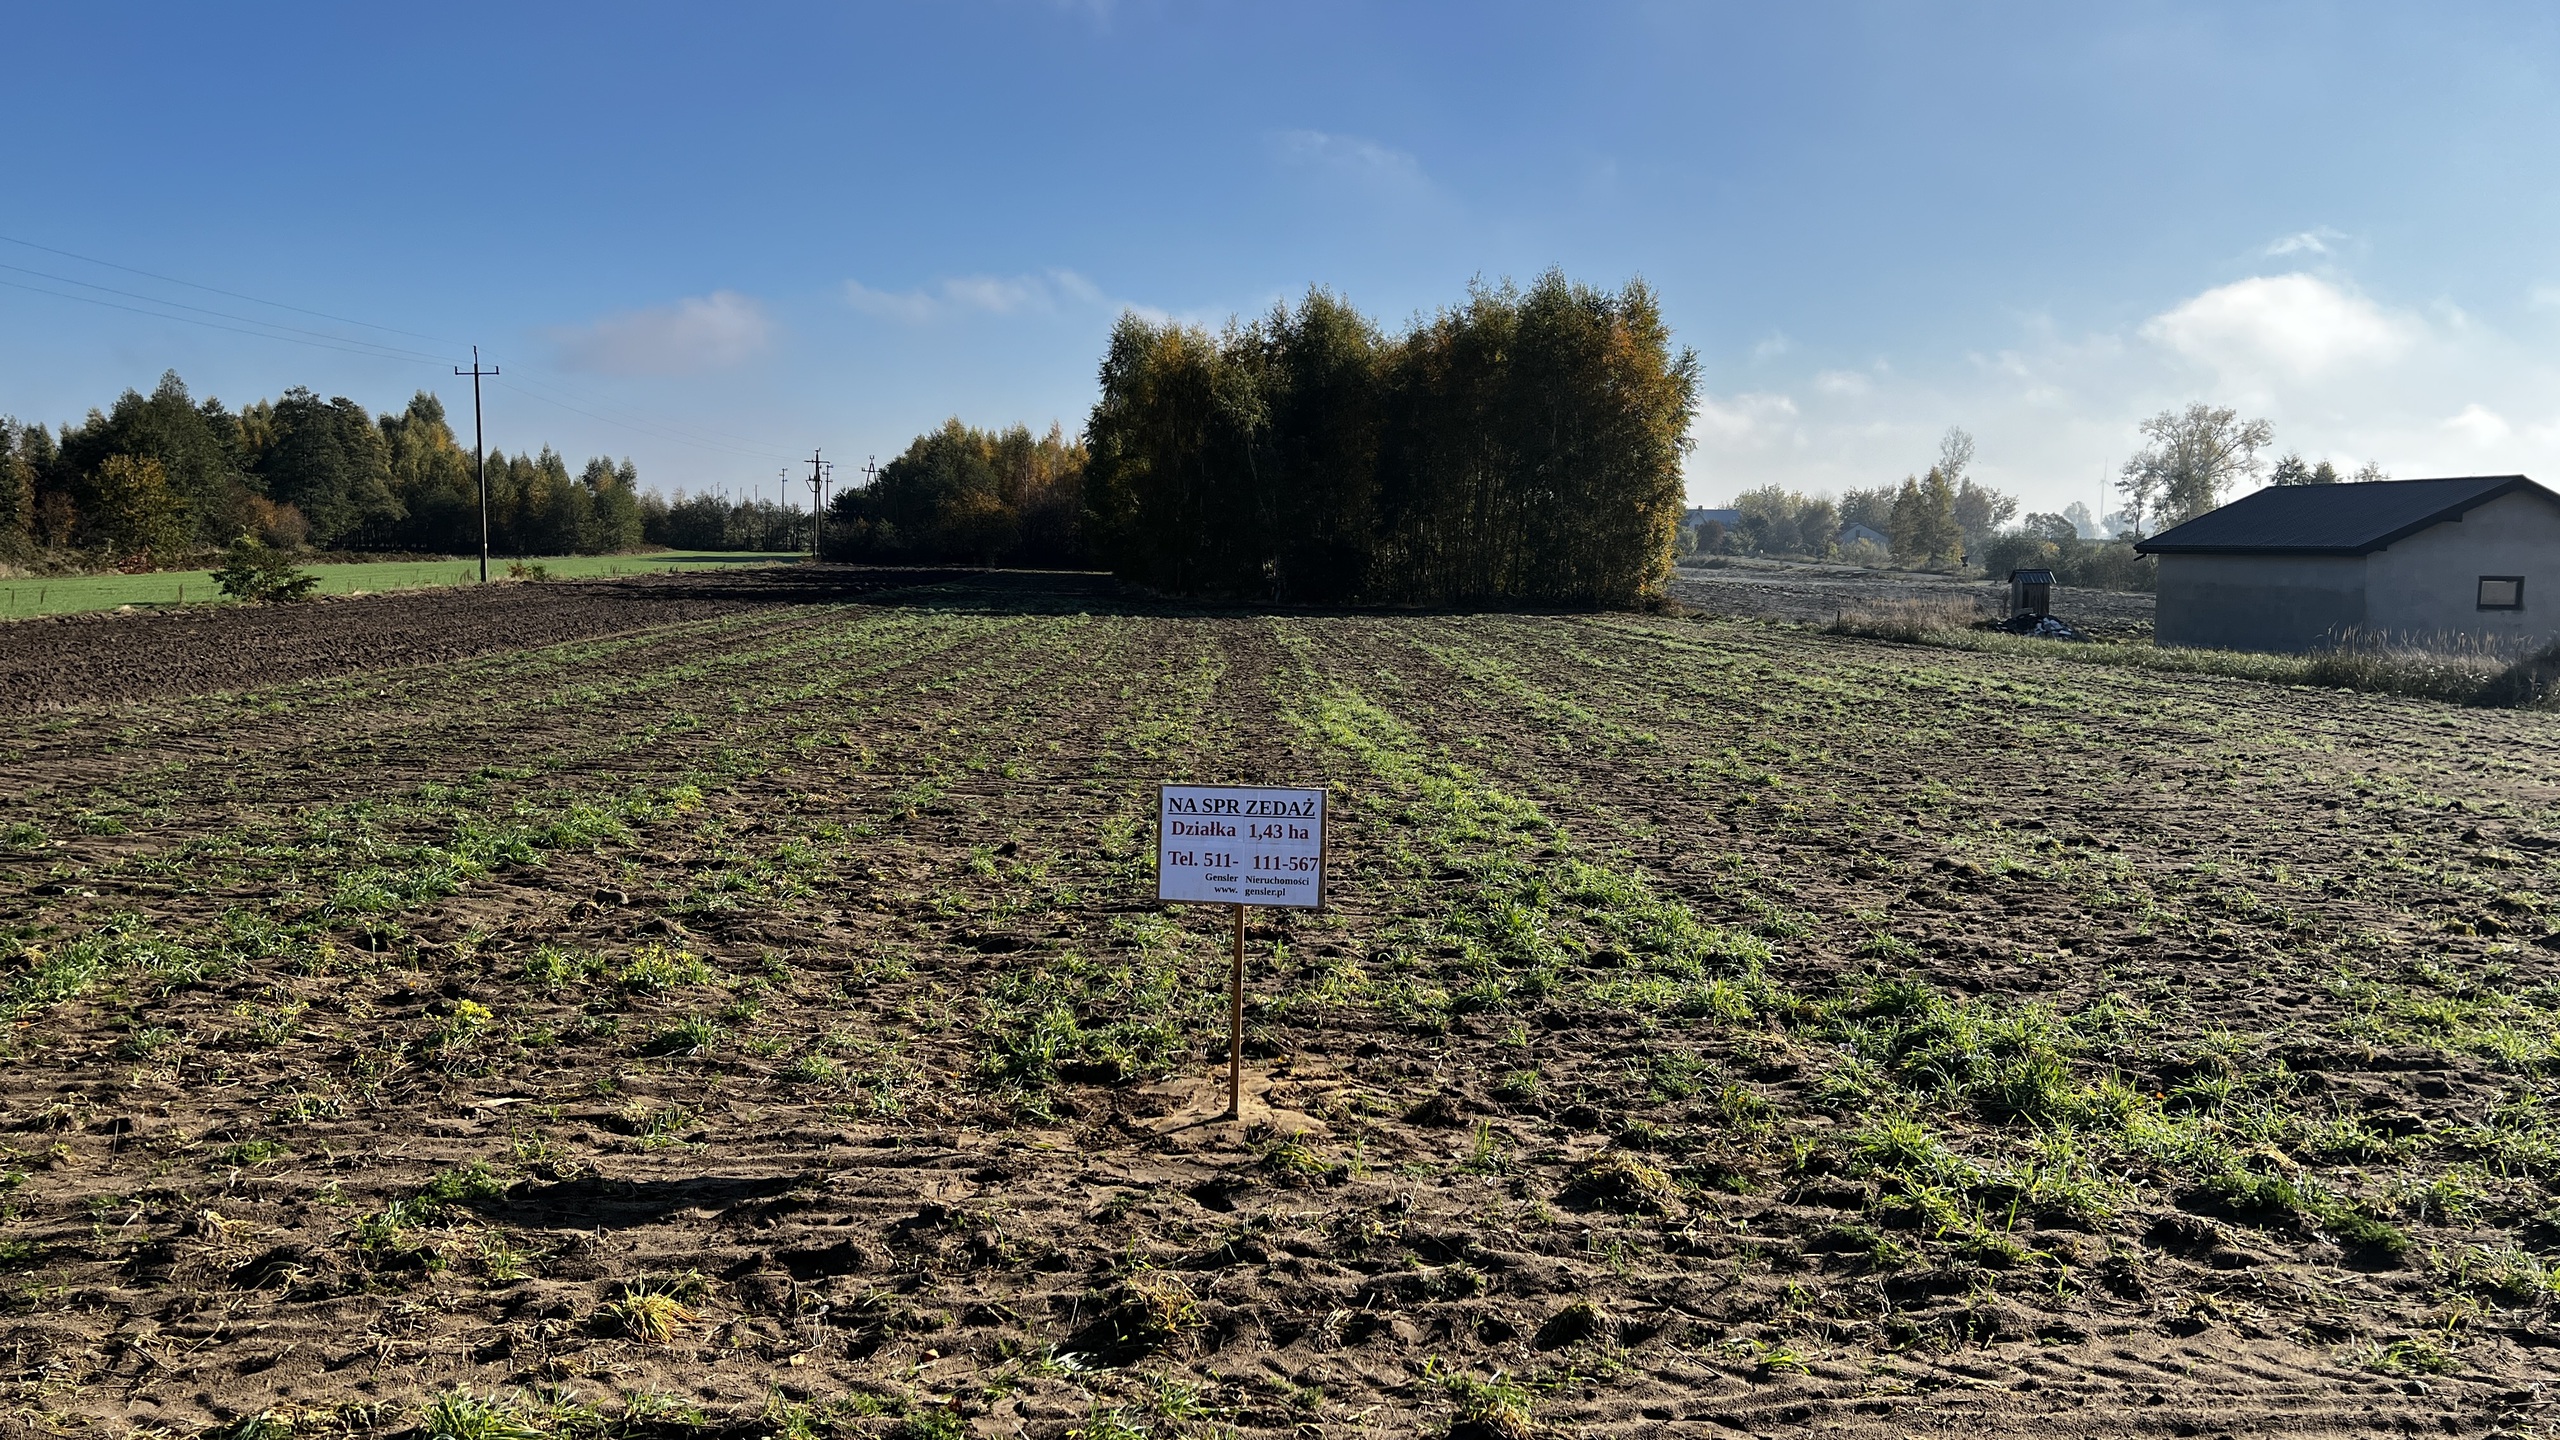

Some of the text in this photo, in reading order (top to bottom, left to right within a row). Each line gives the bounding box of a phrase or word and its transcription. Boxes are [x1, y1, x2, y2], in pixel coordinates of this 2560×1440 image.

[1168, 797, 1198, 813] NA
[1171, 820, 1309, 841] Działka 1,43 ha
[1168, 851, 1198, 866] Tel.
[1205, 873, 1310, 886] Gensler Nieruchomości
